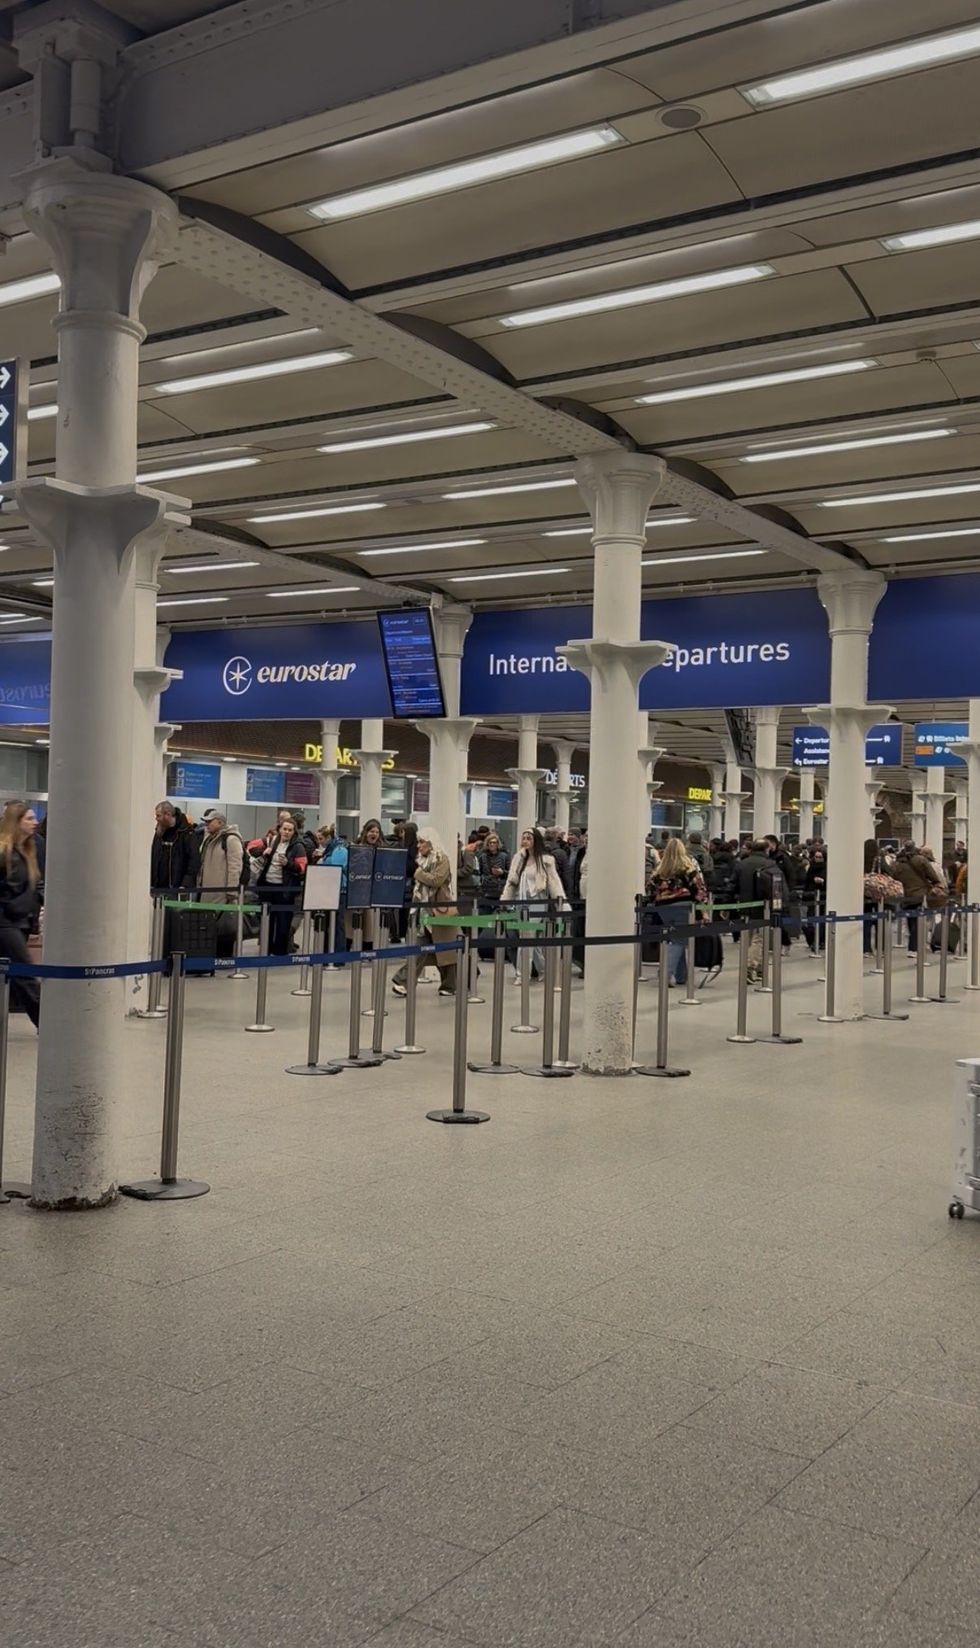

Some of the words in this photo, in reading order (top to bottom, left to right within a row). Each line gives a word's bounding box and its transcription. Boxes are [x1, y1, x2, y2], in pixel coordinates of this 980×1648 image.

[256, 660, 358, 684] eurostar
[489, 654, 577, 675] Interna
[661, 642, 791, 673] epartures
